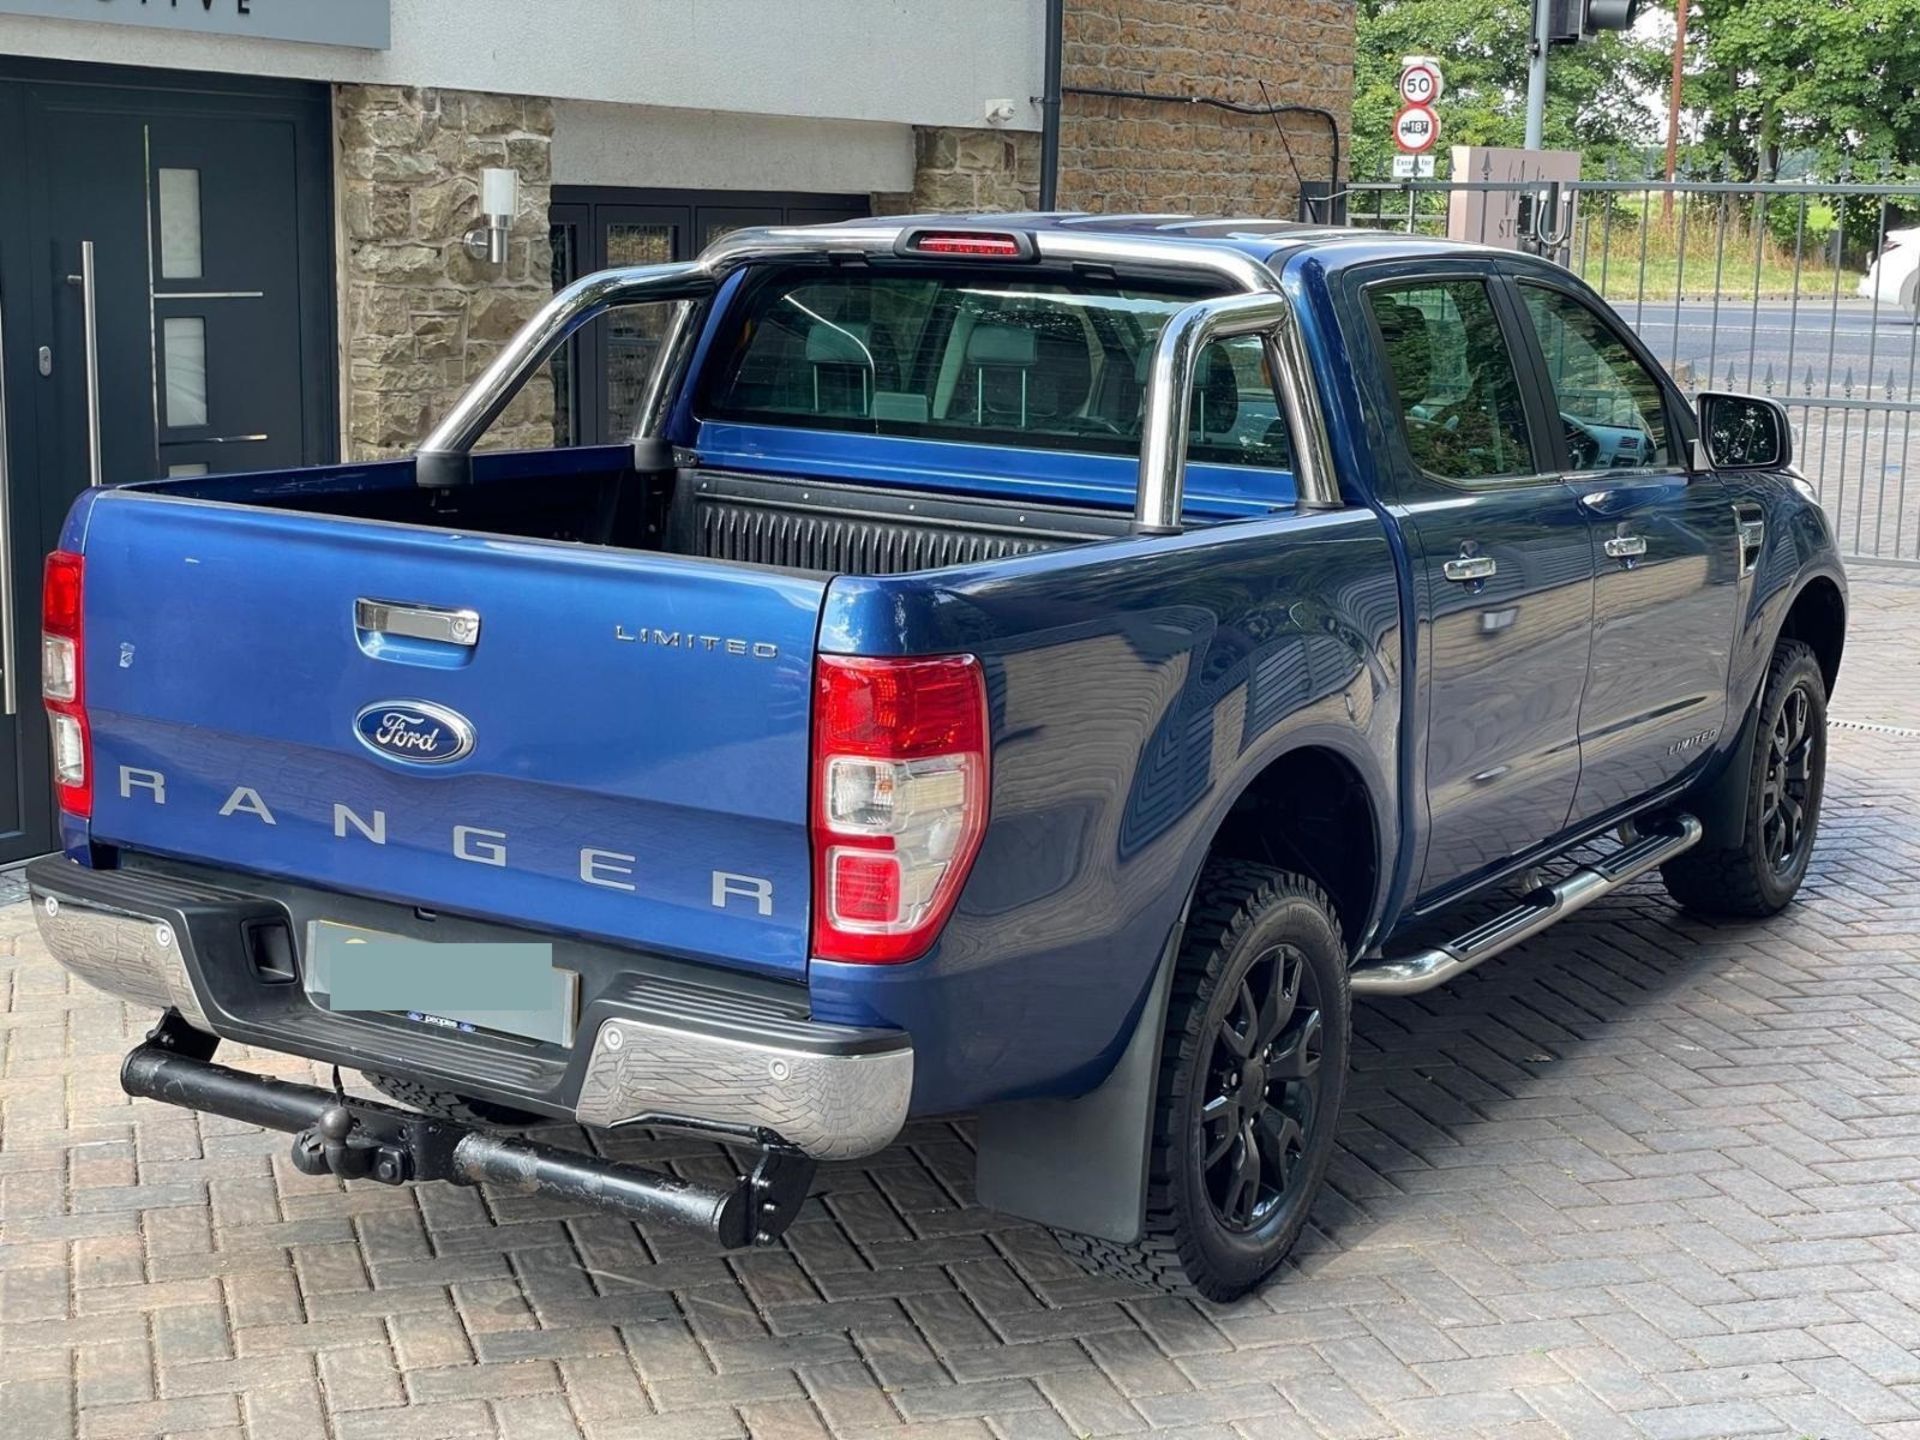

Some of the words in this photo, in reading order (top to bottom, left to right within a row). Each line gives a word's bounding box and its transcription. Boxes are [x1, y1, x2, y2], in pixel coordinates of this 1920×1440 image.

[1406, 78, 1430, 94] 50
[615, 625, 779, 658] LIMITED
[1667, 729, 1717, 756] LIMITED
[119, 765, 773, 916] RANGER
